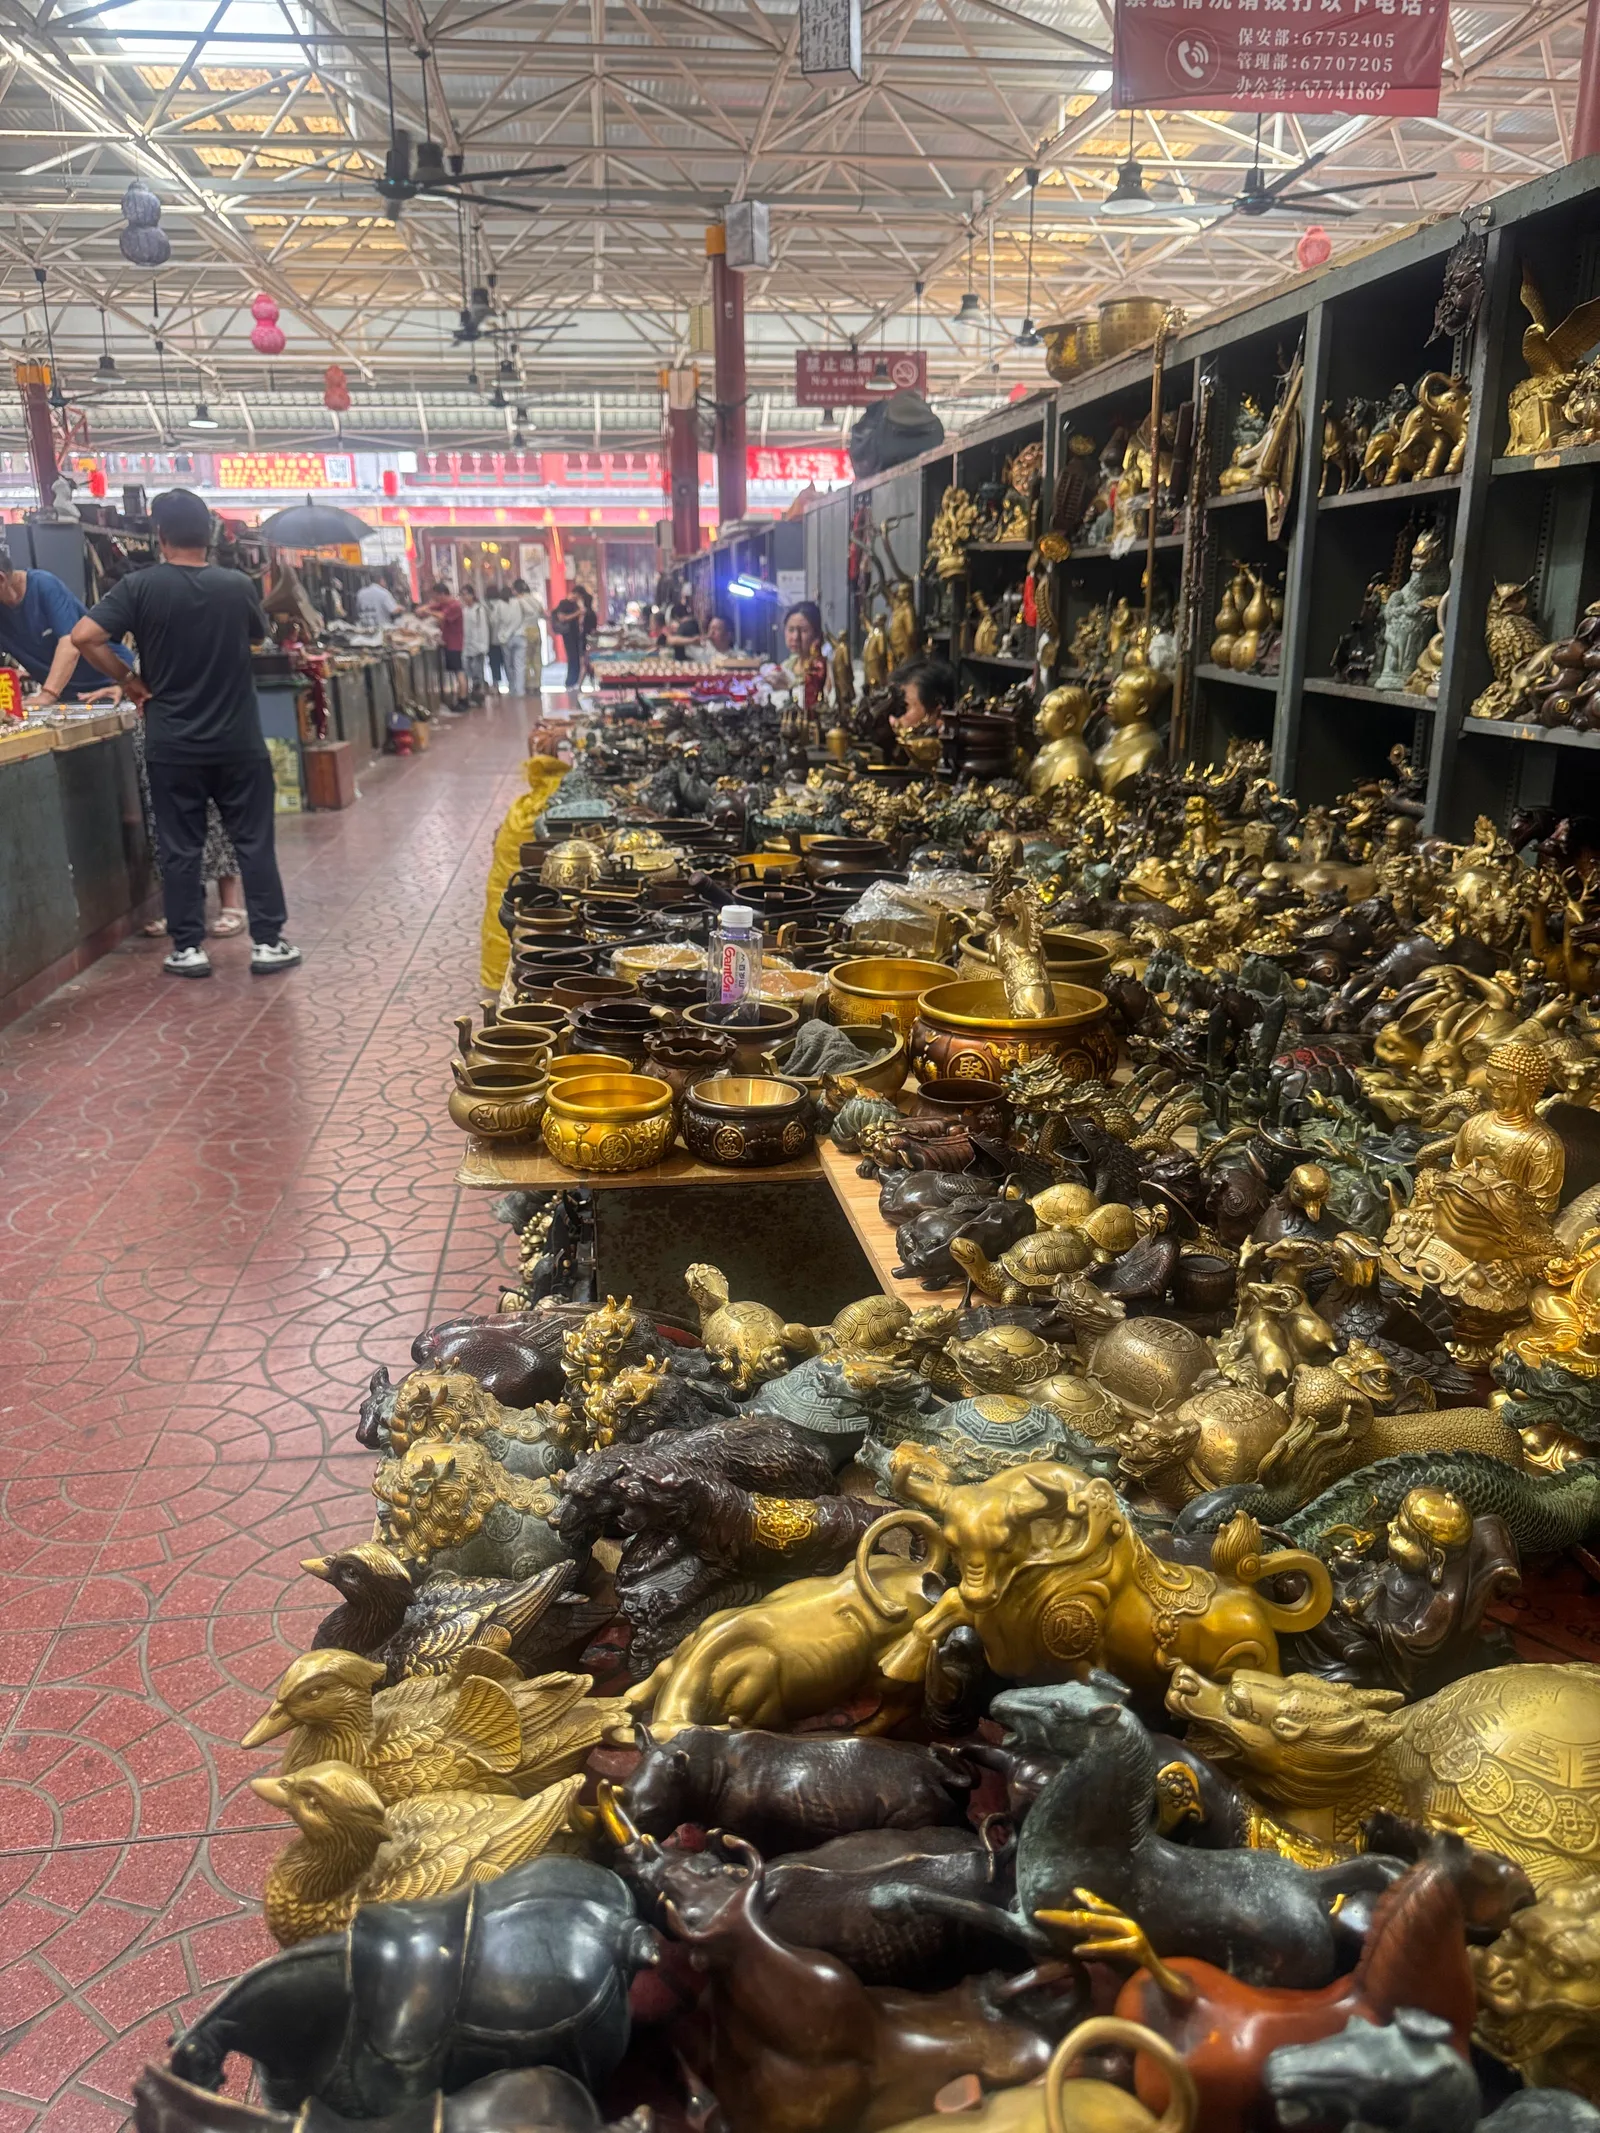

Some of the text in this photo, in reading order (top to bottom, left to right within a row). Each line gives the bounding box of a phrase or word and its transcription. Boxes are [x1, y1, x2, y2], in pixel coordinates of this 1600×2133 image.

[1238, 27, 1395, 48] 保安部:67752405
[1237, 52, 1393, 72] 管理部:67707205
[810, 375, 829, 386] No
